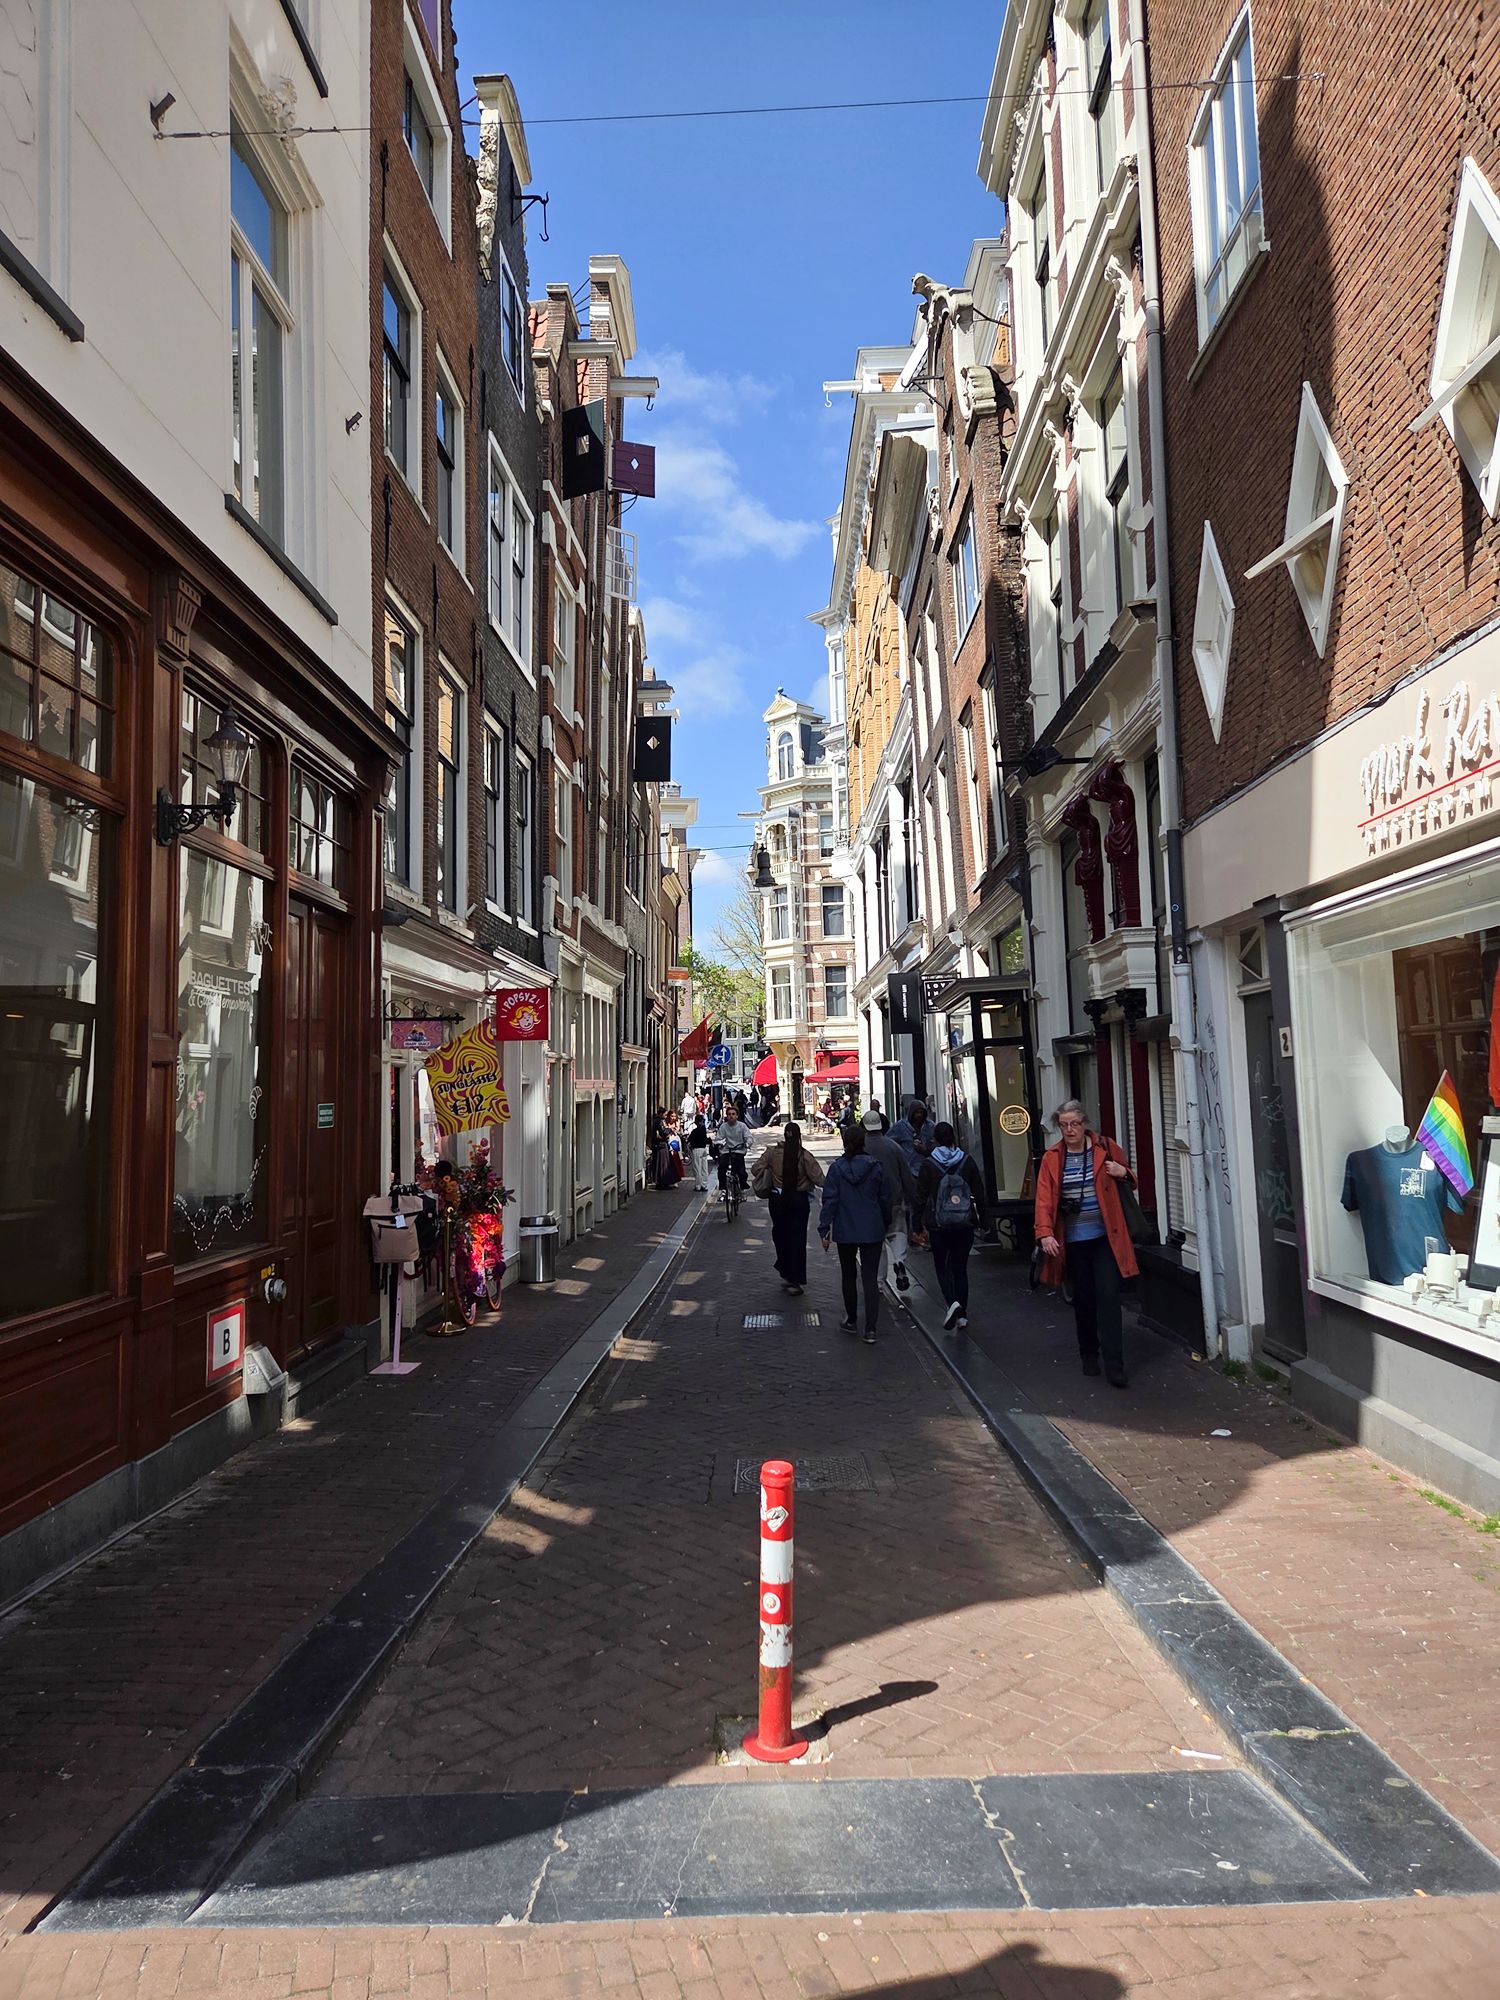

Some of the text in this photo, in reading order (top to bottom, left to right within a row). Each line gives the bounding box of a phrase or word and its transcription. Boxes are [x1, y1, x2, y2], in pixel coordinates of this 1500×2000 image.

[1363, 777, 1492, 847] AMSTERDAM
[189, 970, 251, 996] BAGUETTES
[187, 988, 196, 1008] &
[504, 992, 537, 1010] POPSYZ
[457, 1064, 475, 1075] ALL
[438, 1072, 498, 1094] SUNGLASSES
[223, 1329, 231, 1355] B
